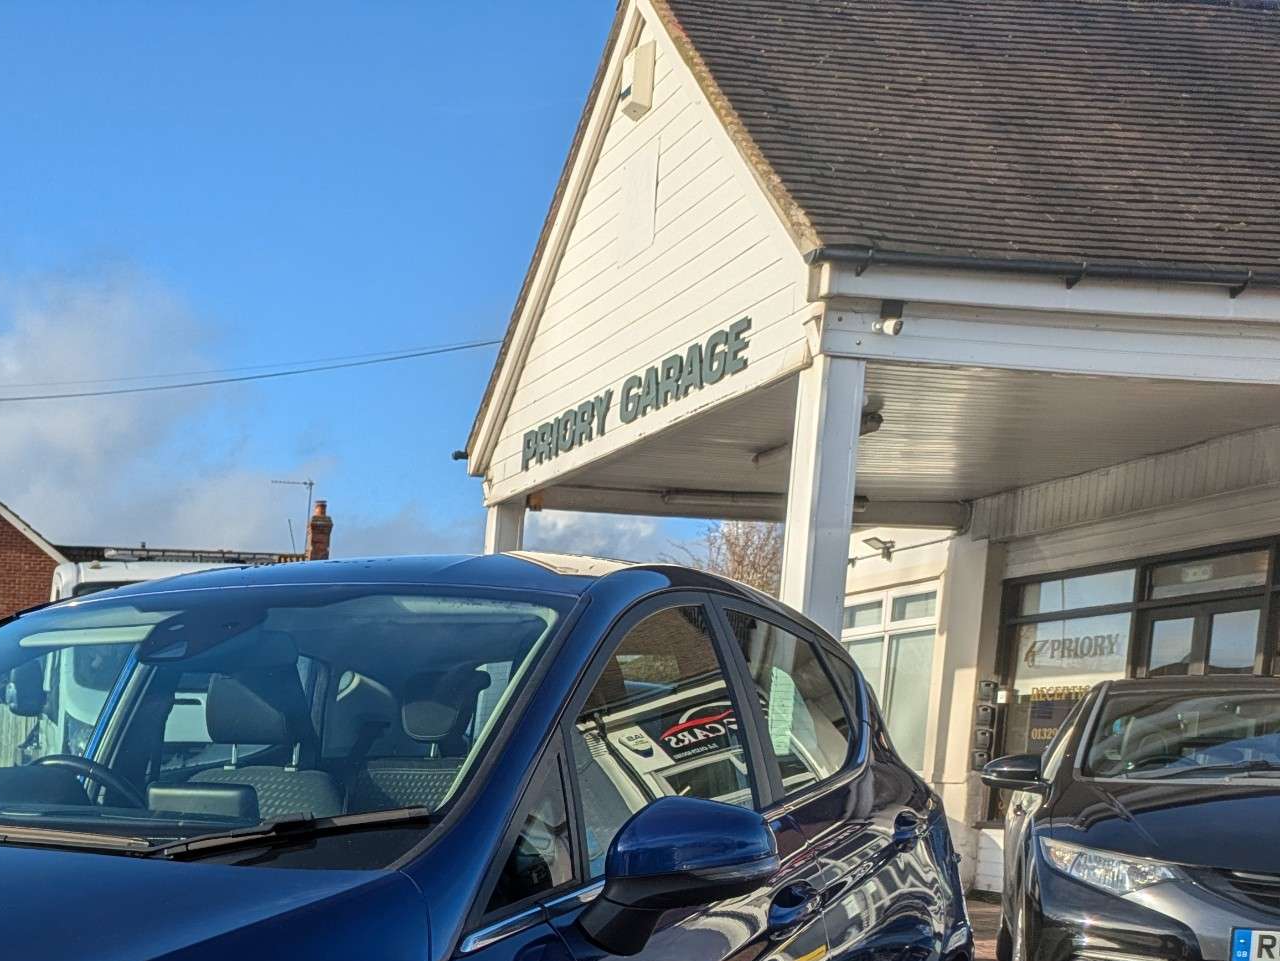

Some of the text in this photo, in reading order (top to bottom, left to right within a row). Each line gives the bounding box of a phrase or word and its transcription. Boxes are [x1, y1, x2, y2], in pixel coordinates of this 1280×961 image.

[521, 315, 752, 472] PRIORY GARAGE
[1049, 633, 1120, 659] PRIORY
